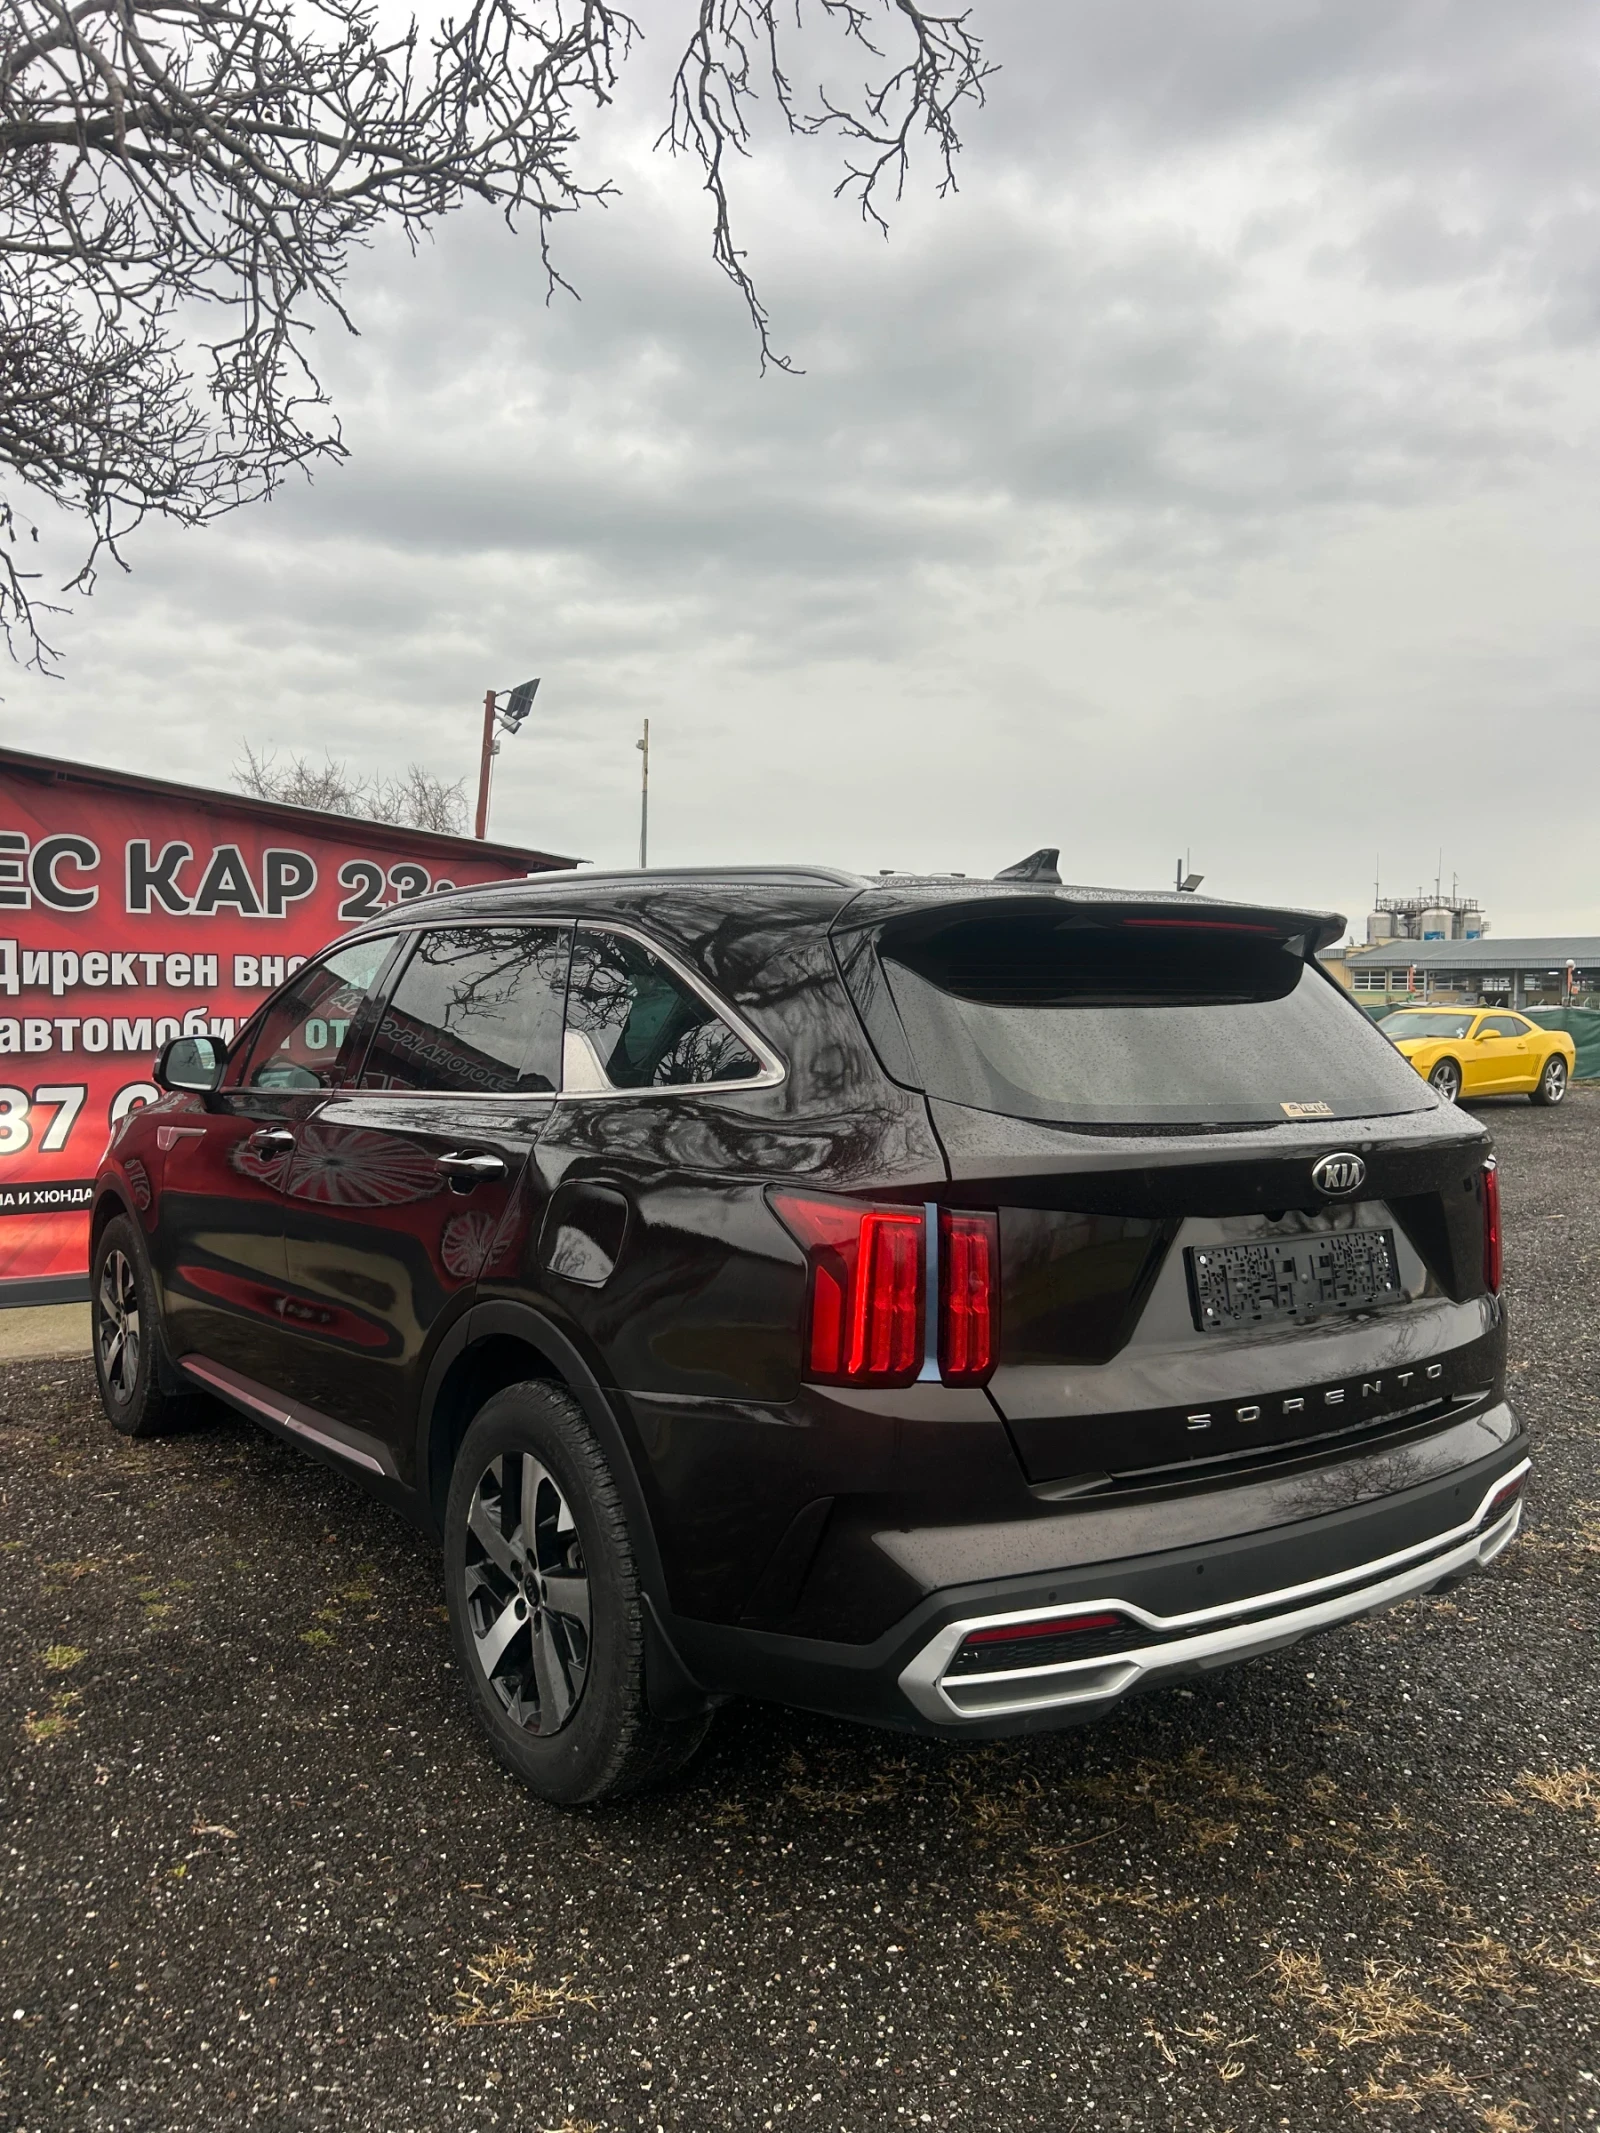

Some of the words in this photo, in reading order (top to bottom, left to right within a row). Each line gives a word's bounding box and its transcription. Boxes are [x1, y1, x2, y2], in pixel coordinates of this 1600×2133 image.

[126, 839, 318, 919] КАР
[337, 859, 456, 921] 23
[1323, 1162, 1360, 1188] KIA
[0, 1193, 16, 1206] А
[18, 1191, 31, 1205] И
[1186, 1363, 1443, 1430] SORENTO
